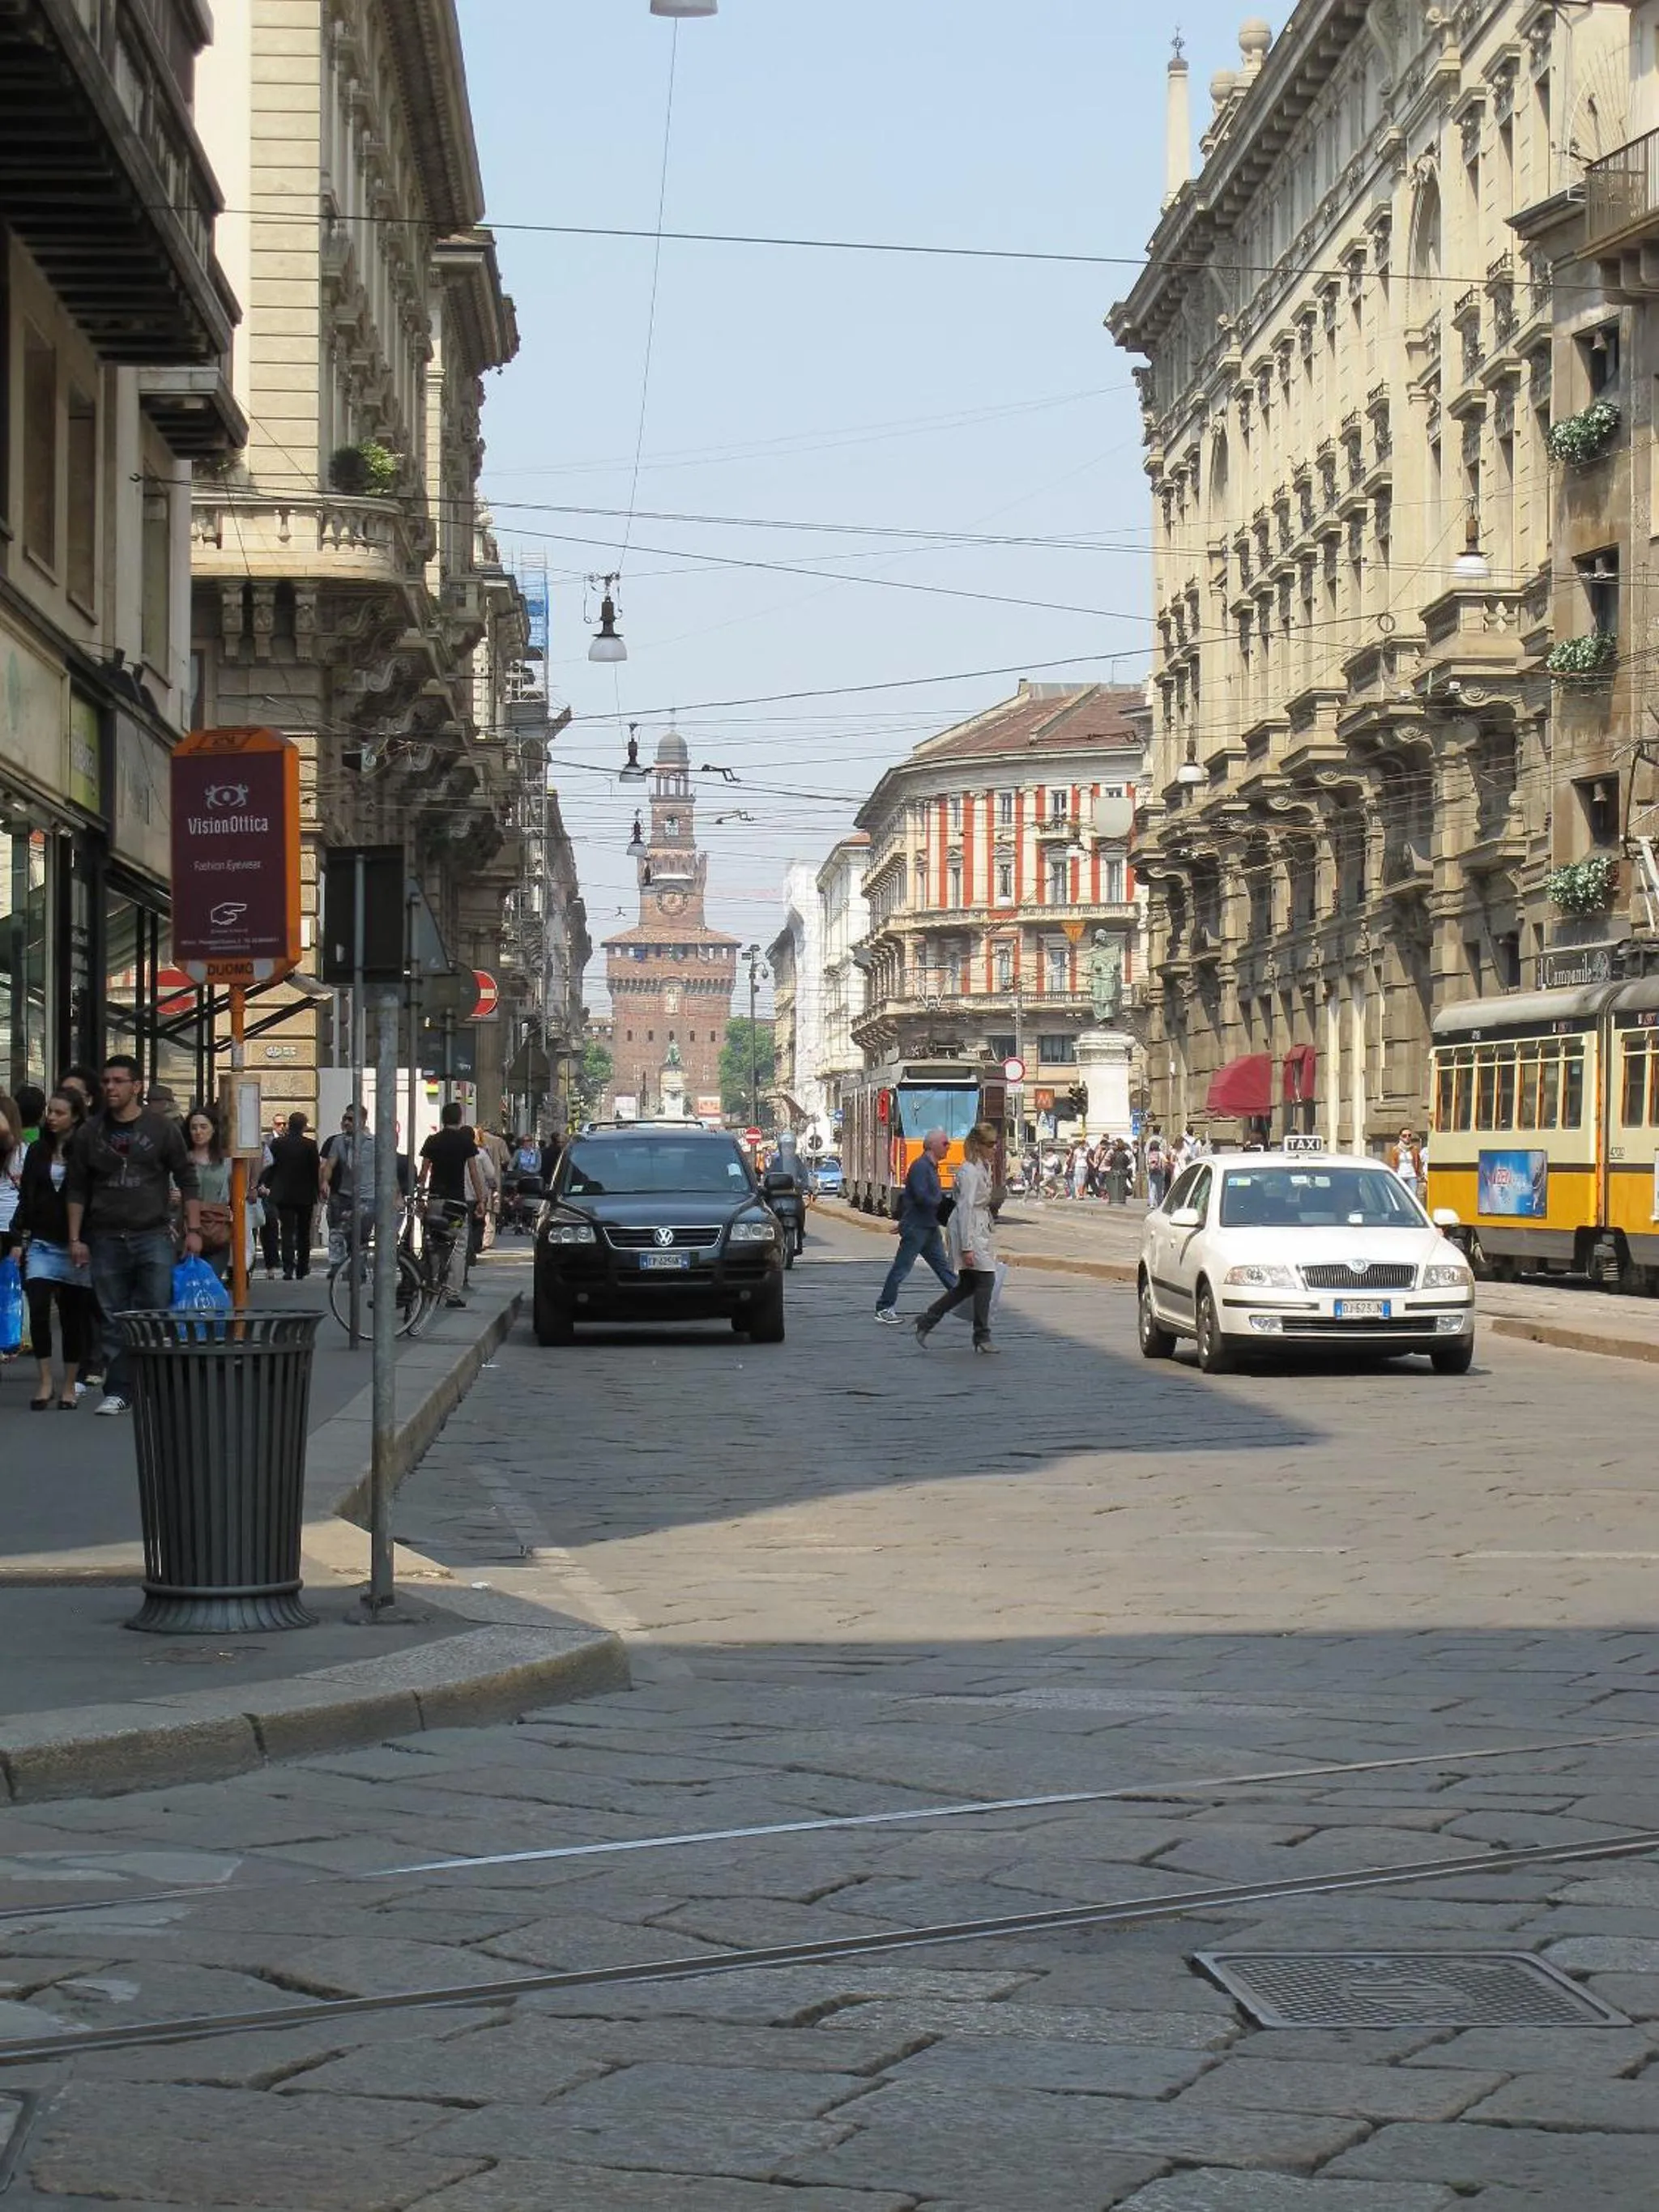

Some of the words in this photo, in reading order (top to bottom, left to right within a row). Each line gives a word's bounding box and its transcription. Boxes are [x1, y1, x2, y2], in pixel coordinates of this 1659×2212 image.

[188, 815, 269, 835] VisionOttica
[194, 861, 225, 871] Fashion
[207, 961, 254, 976] DUOMO
[1546, 952, 1592, 987] Campanile
[1289, 1139, 1320, 1149] TAXI
